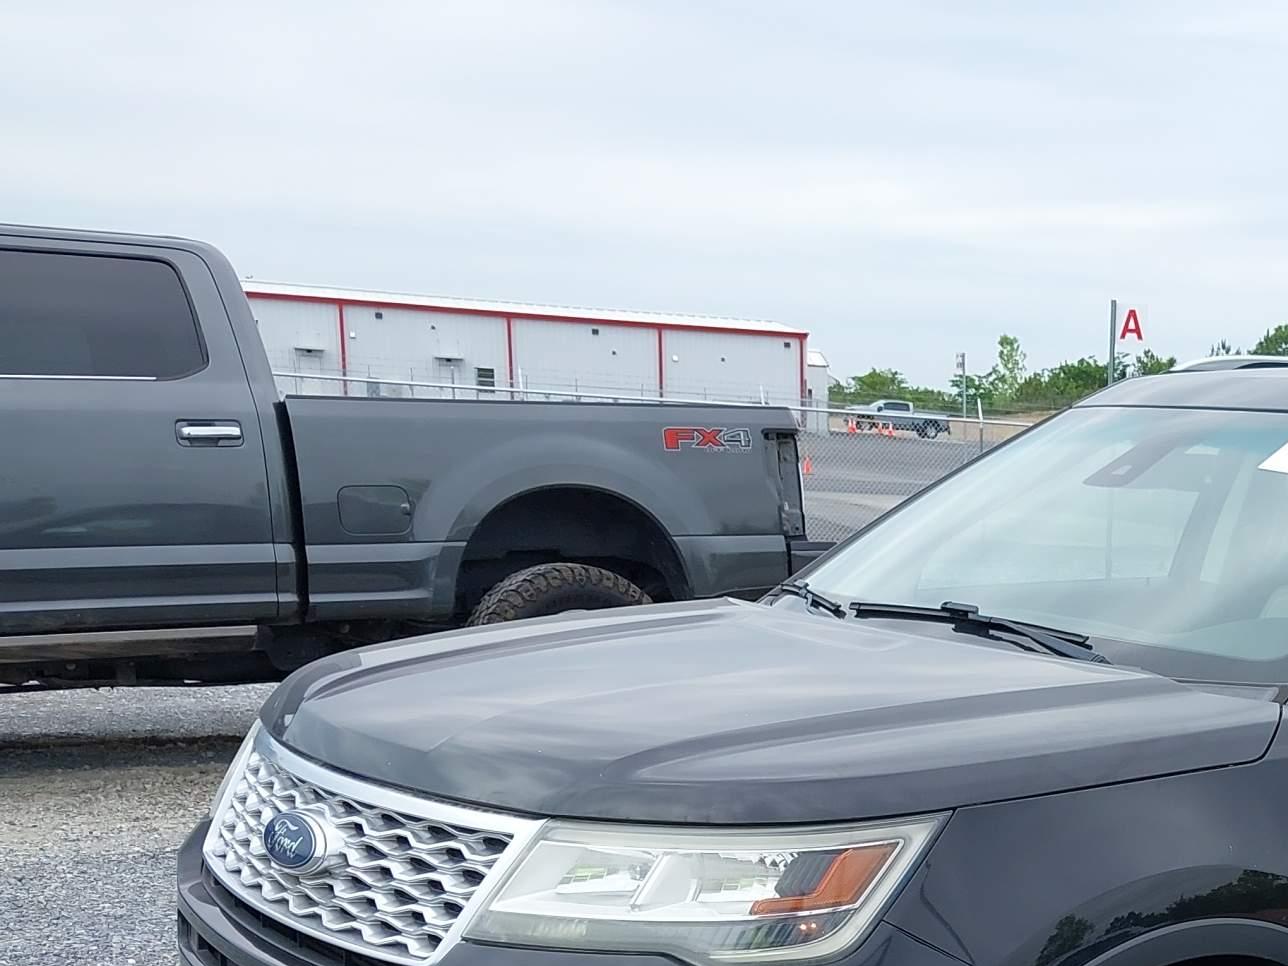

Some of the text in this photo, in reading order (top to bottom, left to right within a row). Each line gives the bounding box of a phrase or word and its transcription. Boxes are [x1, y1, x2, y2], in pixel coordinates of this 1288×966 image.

[1120, 309, 1143, 341] A
[663, 426, 752, 451] FX4
[268, 819, 303, 858] Ford
